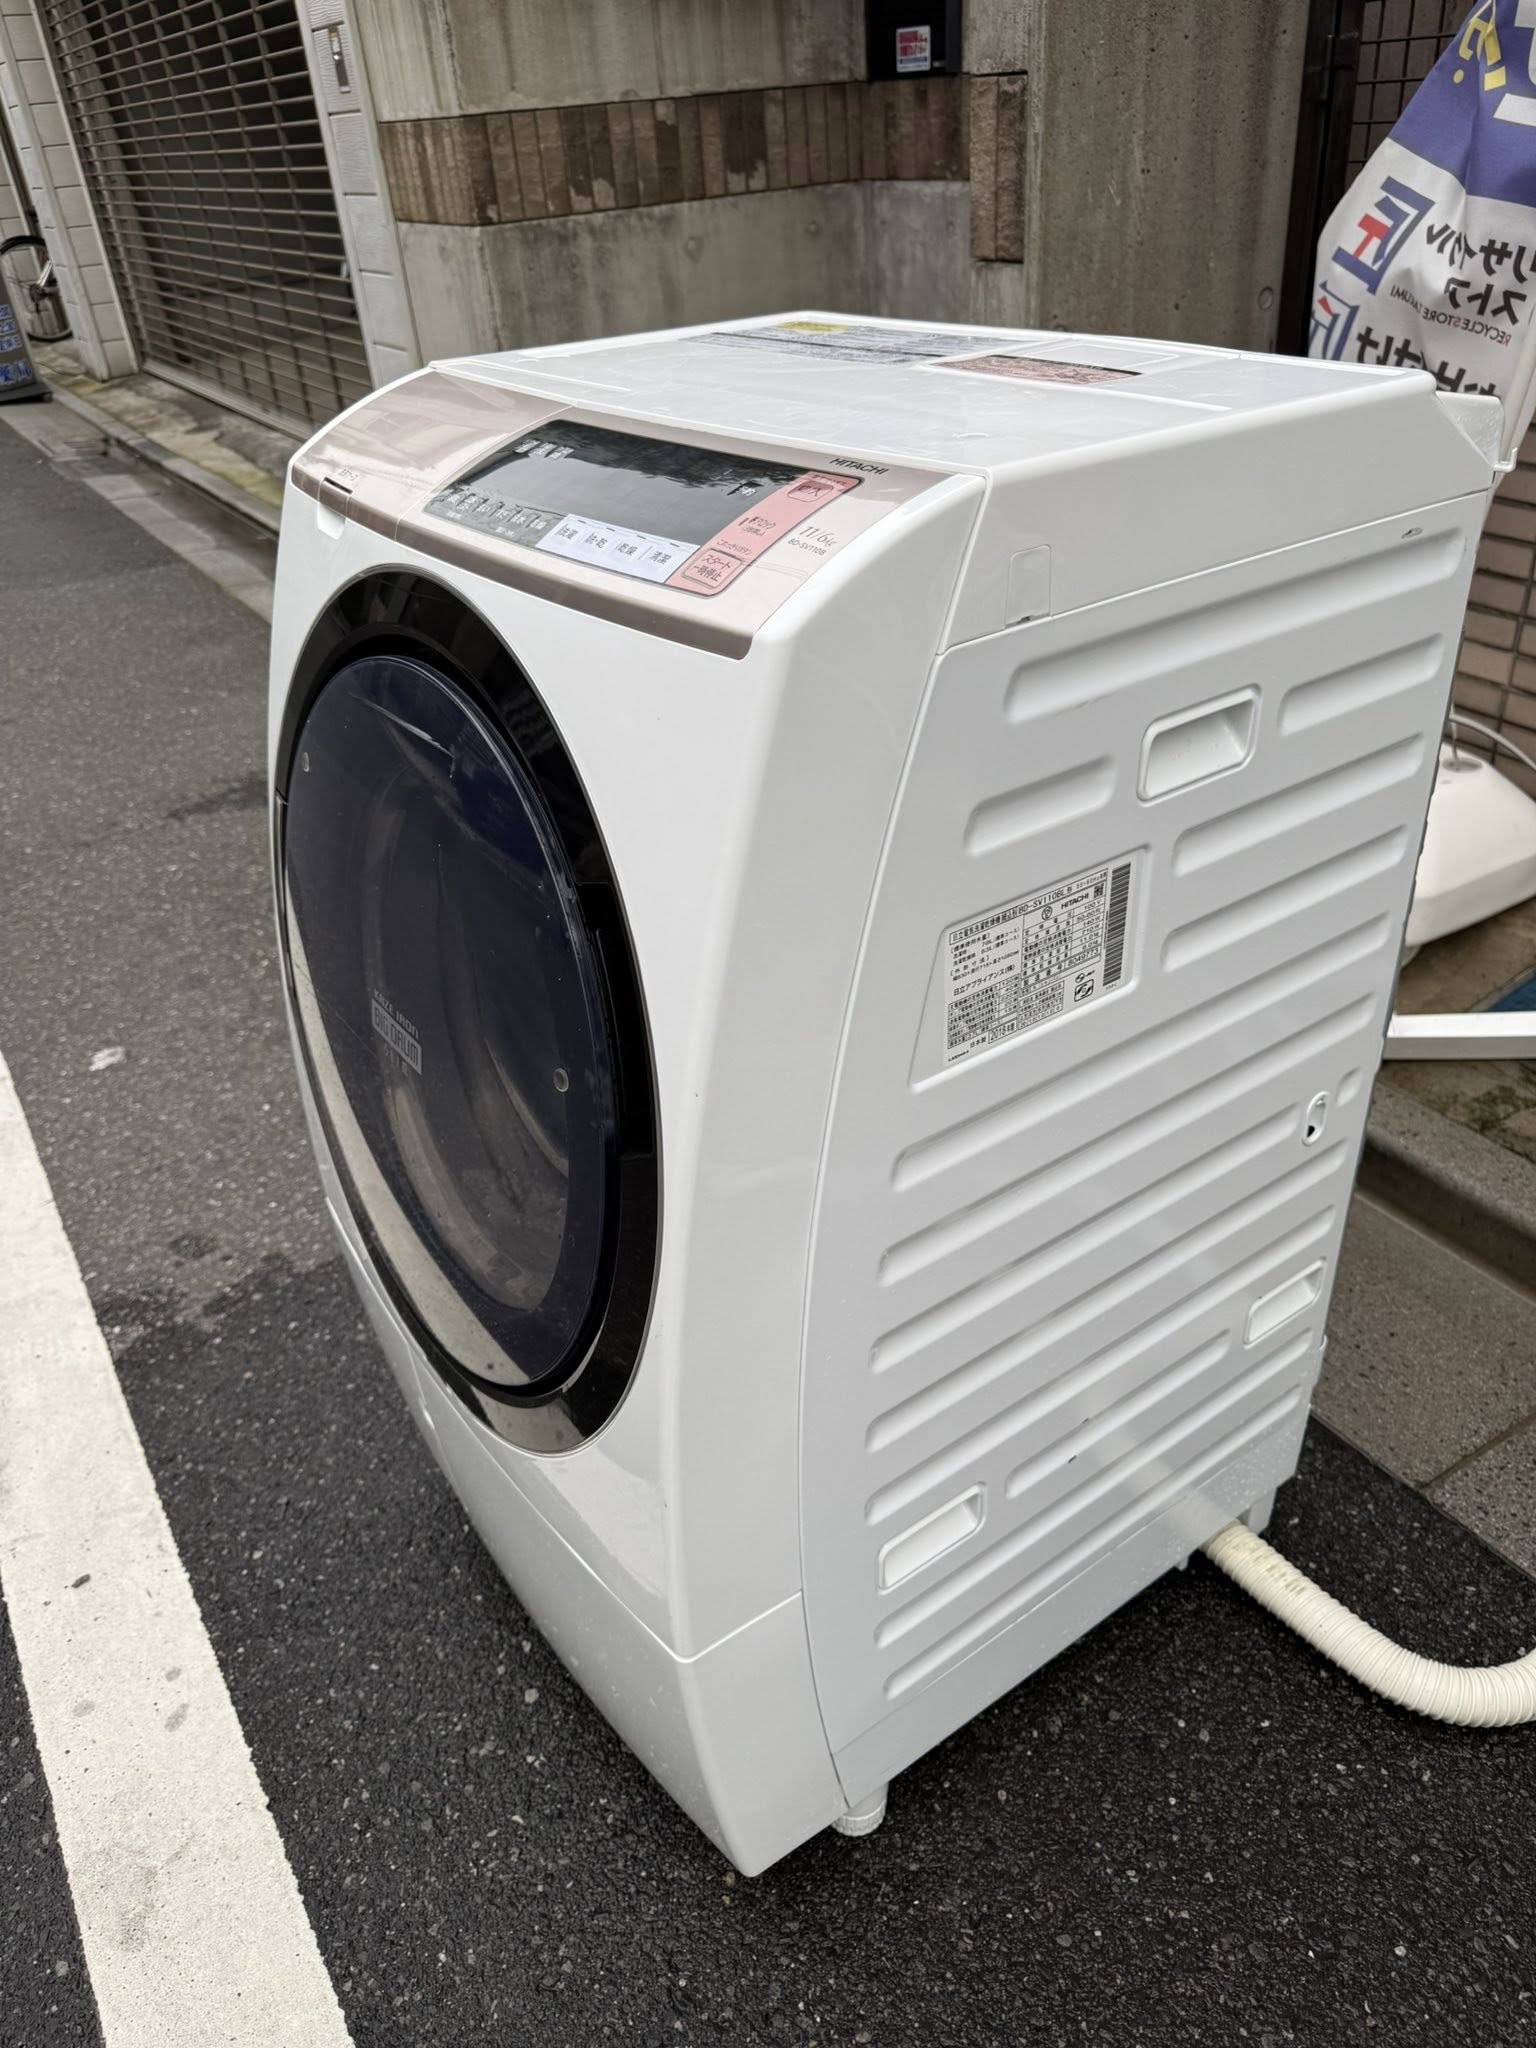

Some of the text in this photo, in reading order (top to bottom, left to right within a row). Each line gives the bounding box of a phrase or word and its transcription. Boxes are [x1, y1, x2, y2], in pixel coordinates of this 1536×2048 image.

[829, 457, 890, 475] HITACHI
[788, 538, 827, 556] BD-SV110B
[702, 554, 732, 570] スタート
[693, 564, 722, 583] 一時停止
[1061, 891, 1088, 909] HITACHI
[953, 963, 1015, 996] 日立アプライアンス(株)
[390, 1023, 419, 1066] DRUM
